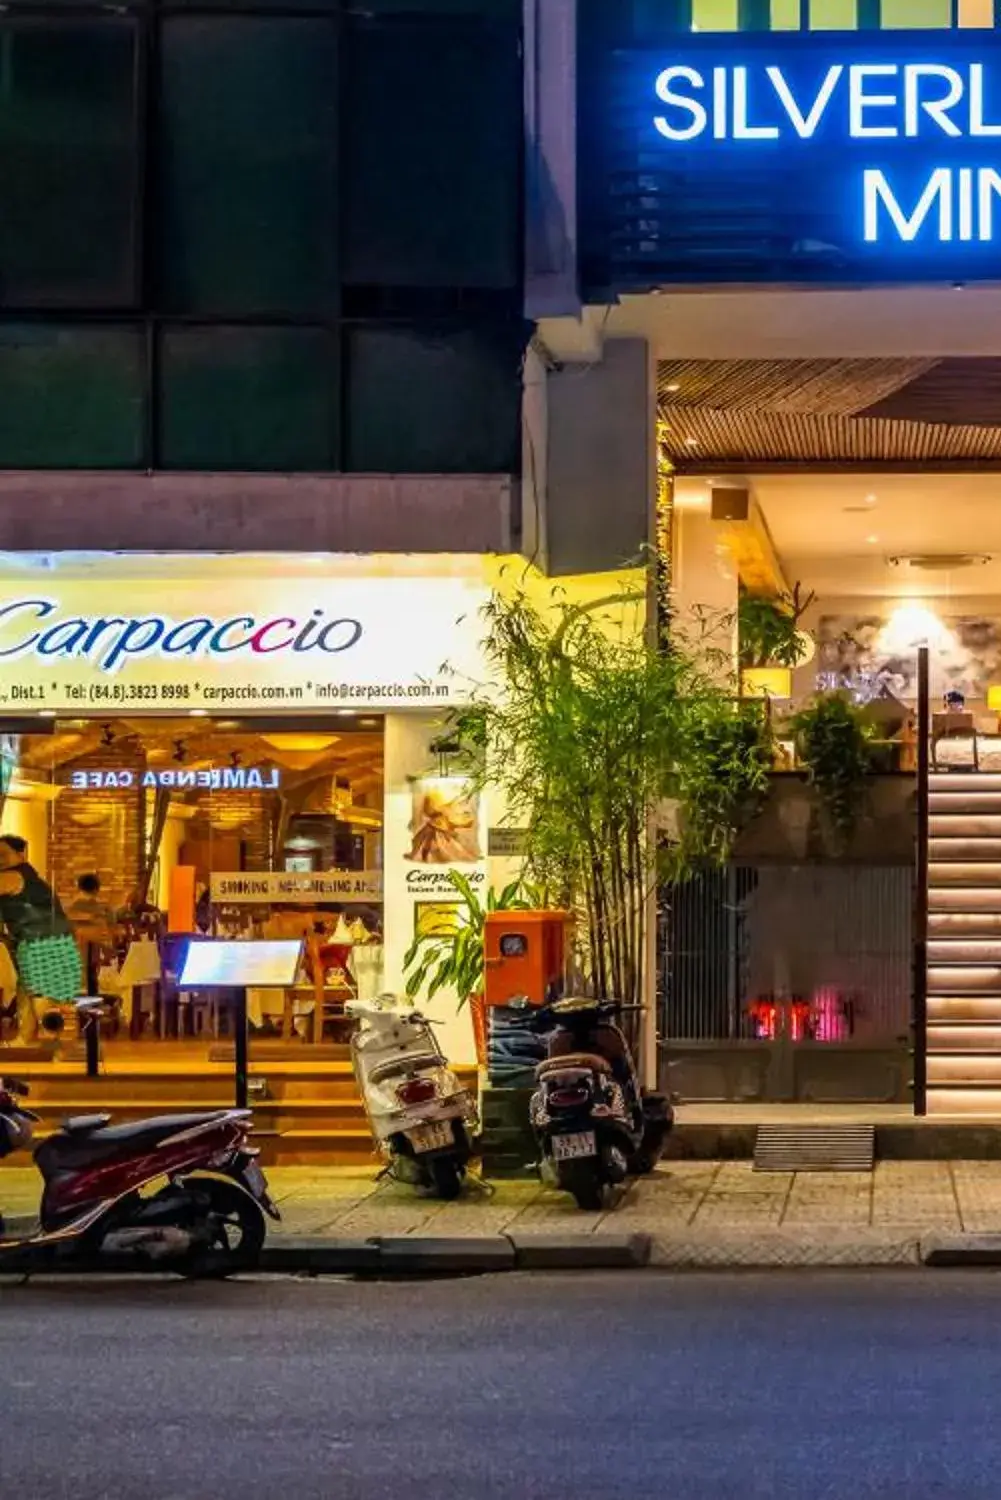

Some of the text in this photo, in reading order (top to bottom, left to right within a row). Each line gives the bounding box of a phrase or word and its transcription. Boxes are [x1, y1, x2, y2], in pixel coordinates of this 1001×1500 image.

[0, 600, 362, 669] Carpaccio
[11, 685, 45, 699] Dist.1
[65, 684, 87, 699] Tel:
[203, 684, 303, 701] carpaccio.com.vn
[315, 683, 449, 699] info@carpaccio.com.vn
